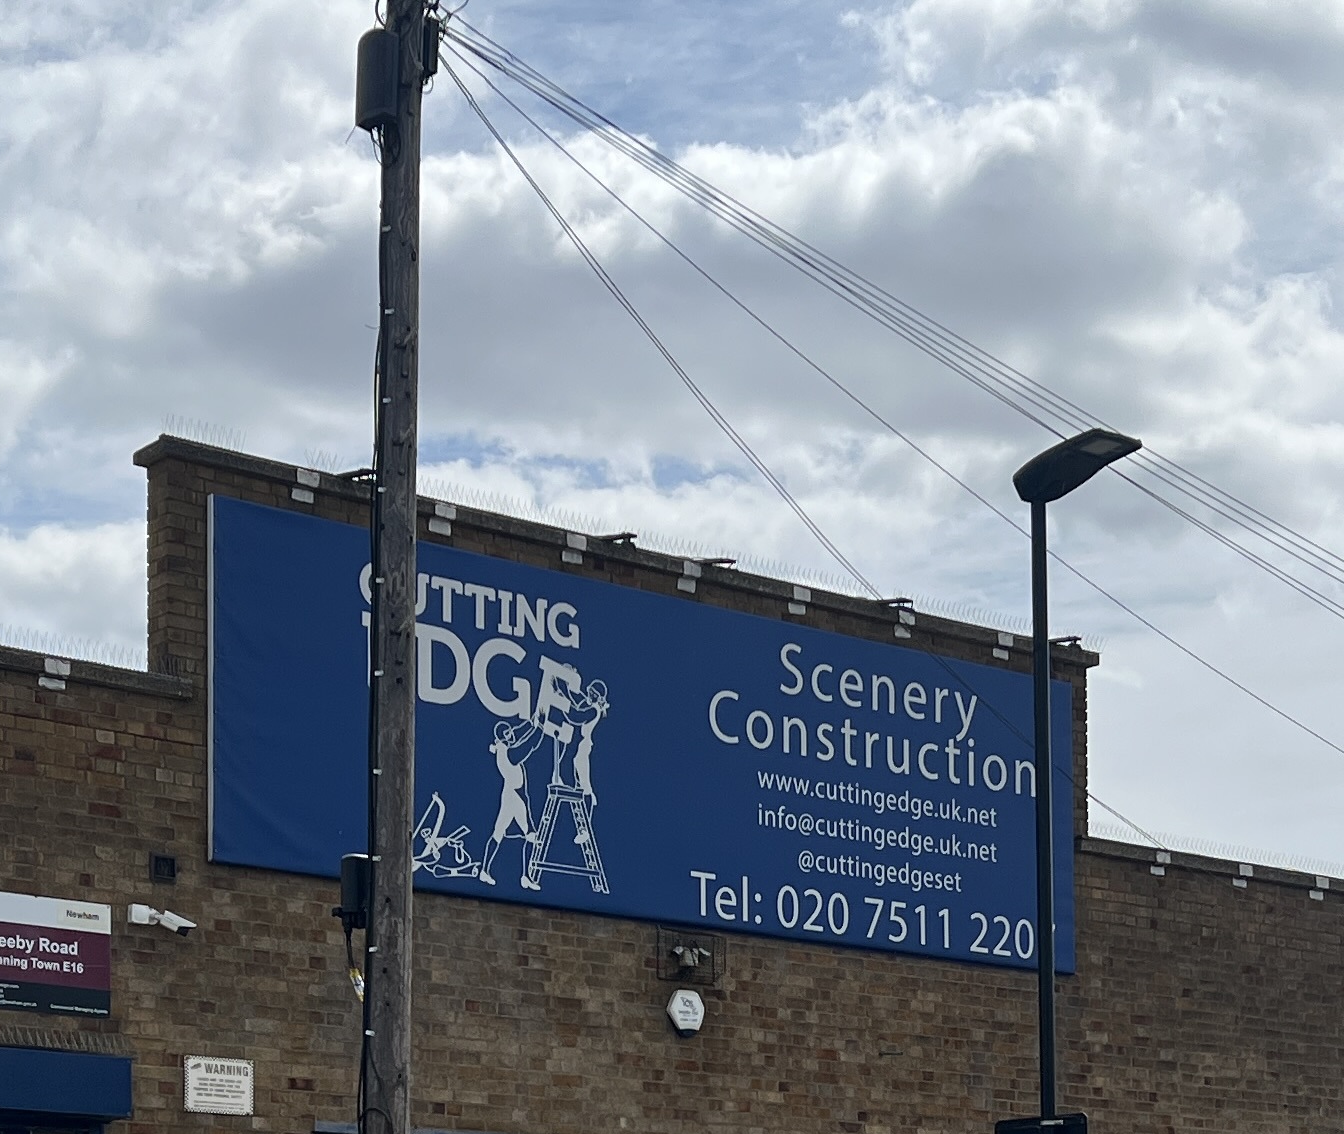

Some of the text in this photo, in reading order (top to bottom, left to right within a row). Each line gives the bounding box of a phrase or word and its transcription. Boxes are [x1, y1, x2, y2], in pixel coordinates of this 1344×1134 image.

[780, 642, 978, 742] Scenery
[709, 690, 1036, 798] Construction
[757, 770, 997, 828] www.cuttingedge.uk.net
[757, 804, 997, 863] info@cuttingedge.uk.net
[798, 850, 962, 893] @cuttingedgeset
[65, 909, 100, 922] Newham
[690, 870, 1036, 960] Tel: 020 7511 220
[30, 957, 60, 972] Town
[63, 961, 84, 974] E16
[38, 937, 79, 956] Road
[204, 1062, 249, 1077] WARNING
